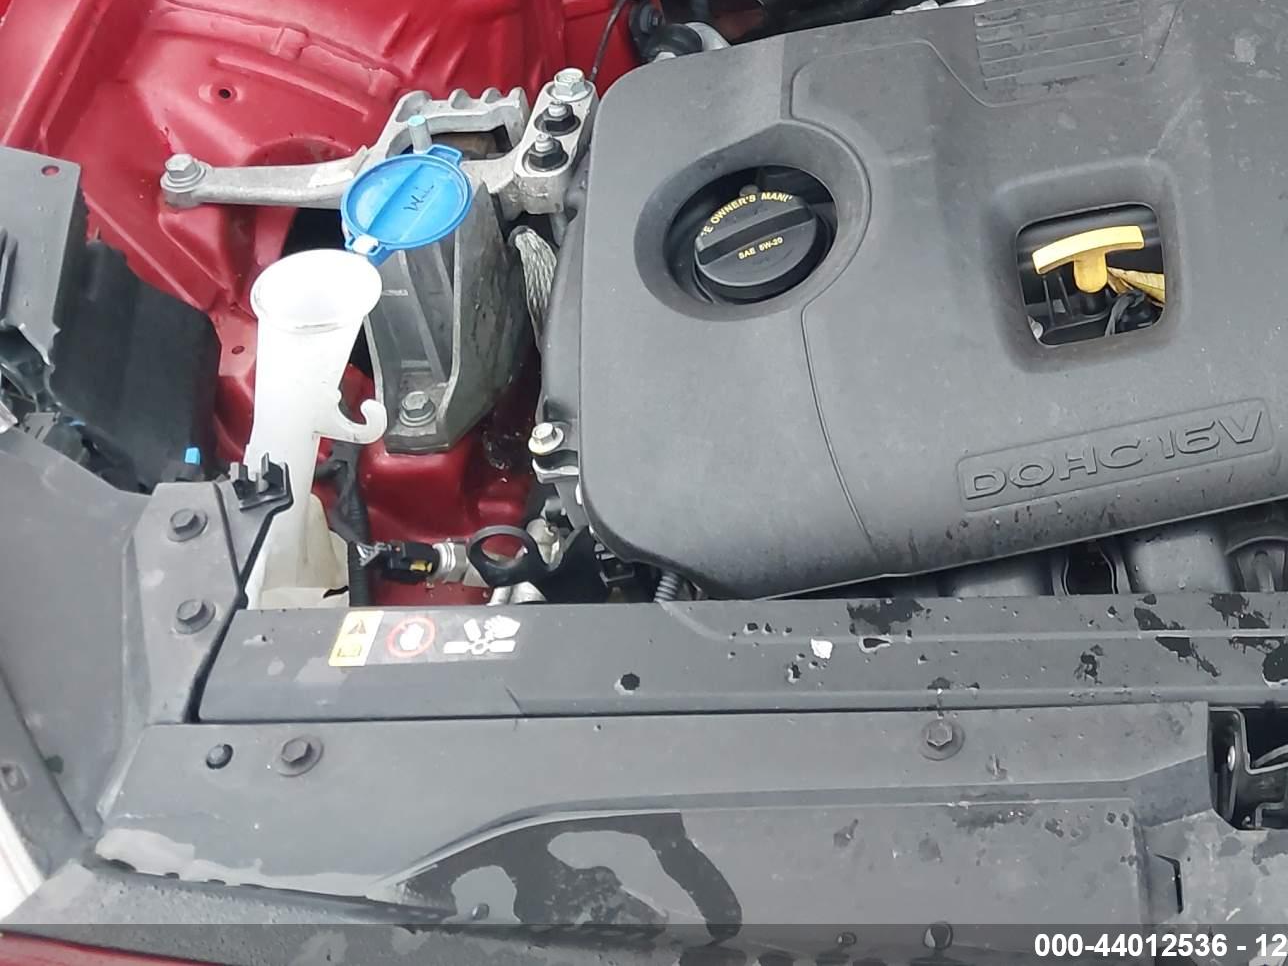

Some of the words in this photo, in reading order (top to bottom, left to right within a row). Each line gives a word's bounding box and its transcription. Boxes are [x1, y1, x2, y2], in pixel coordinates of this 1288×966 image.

[710, 194, 757, 224] OWNER'S
[738, 246, 757, 260] SAE
[964, 439, 1144, 501] DOHC
[1157, 410, 1263, 460] 16V
